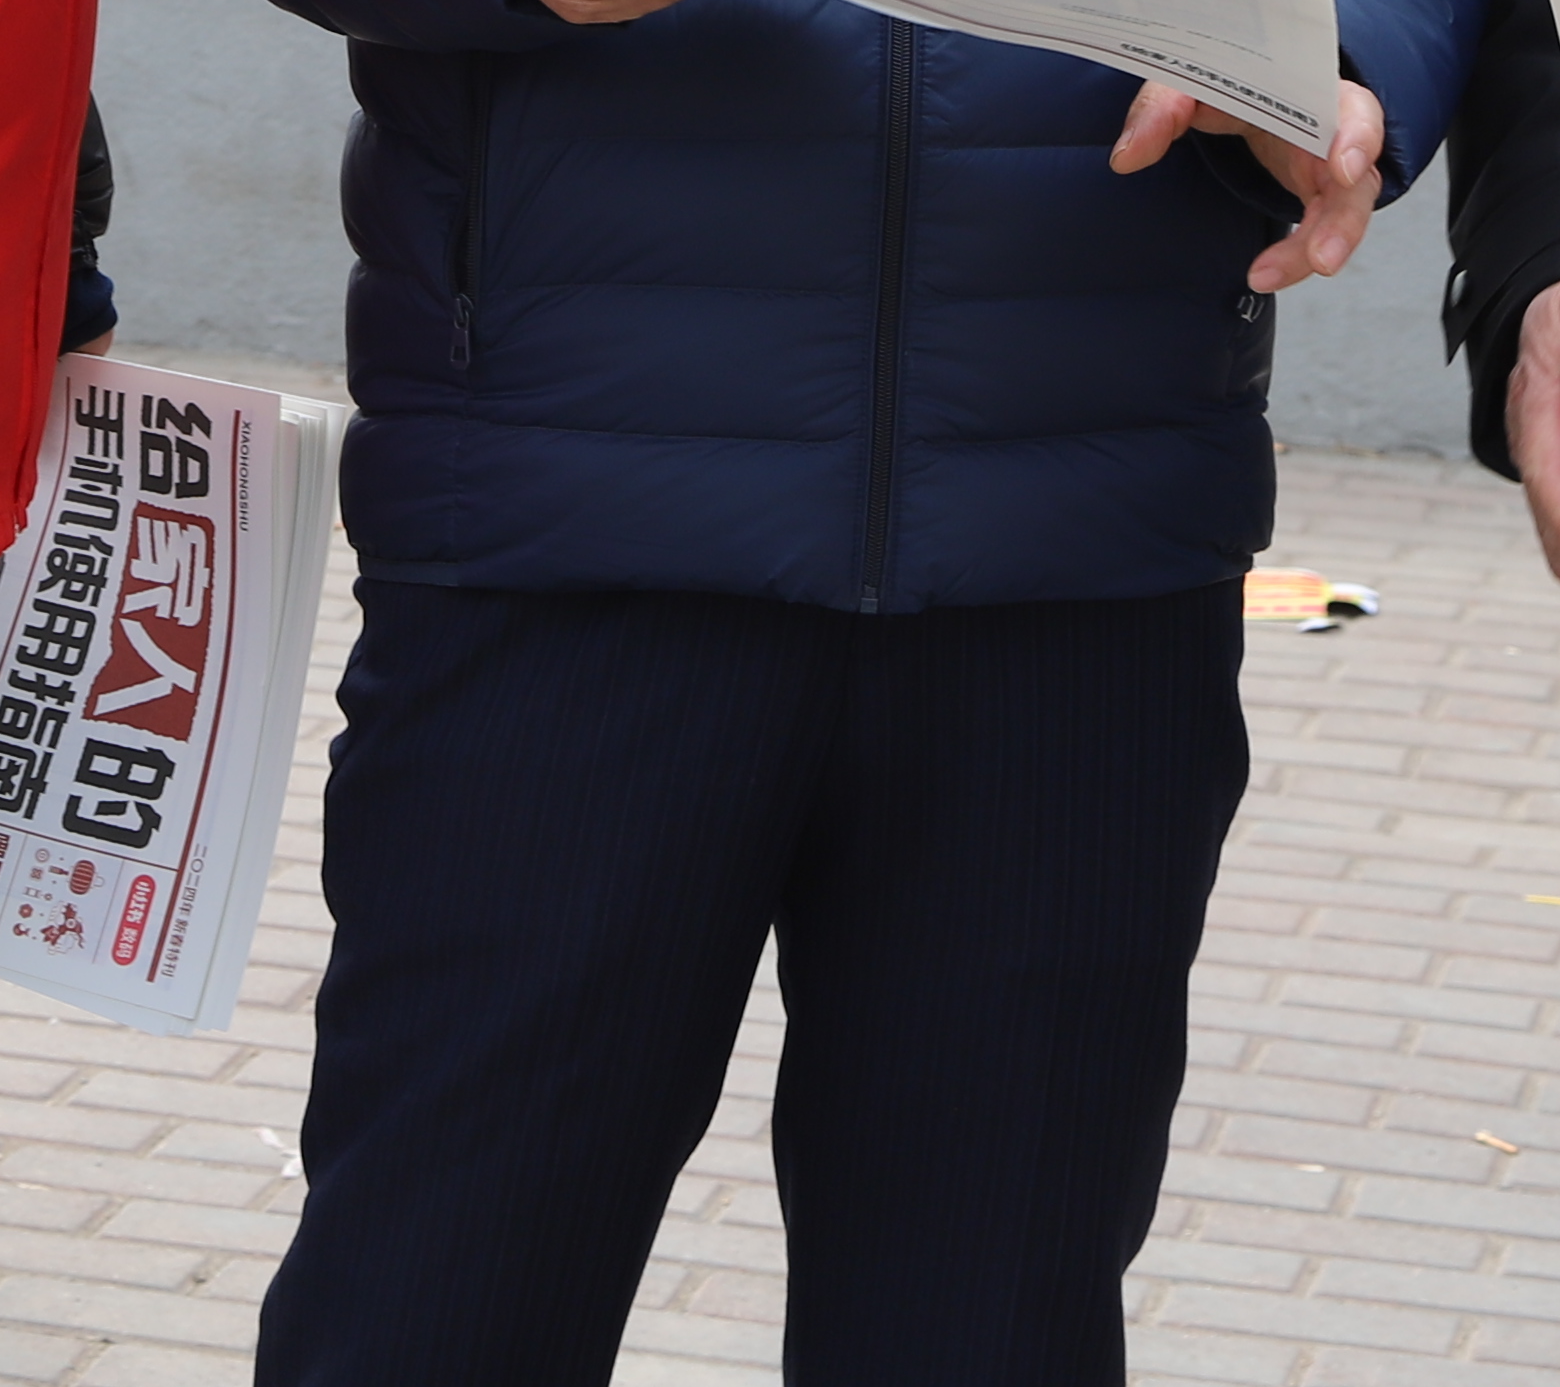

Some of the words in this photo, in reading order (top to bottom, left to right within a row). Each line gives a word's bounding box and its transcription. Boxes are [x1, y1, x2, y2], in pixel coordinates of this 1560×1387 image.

[239, 419, 253, 532] XIAOHONGSHU
[61, 394, 213, 849] 给家人的
[126, 881, 151, 924] 小红书
[115, 927, 139, 959] 数码
[161, 918, 188, 977] 新春特刊
